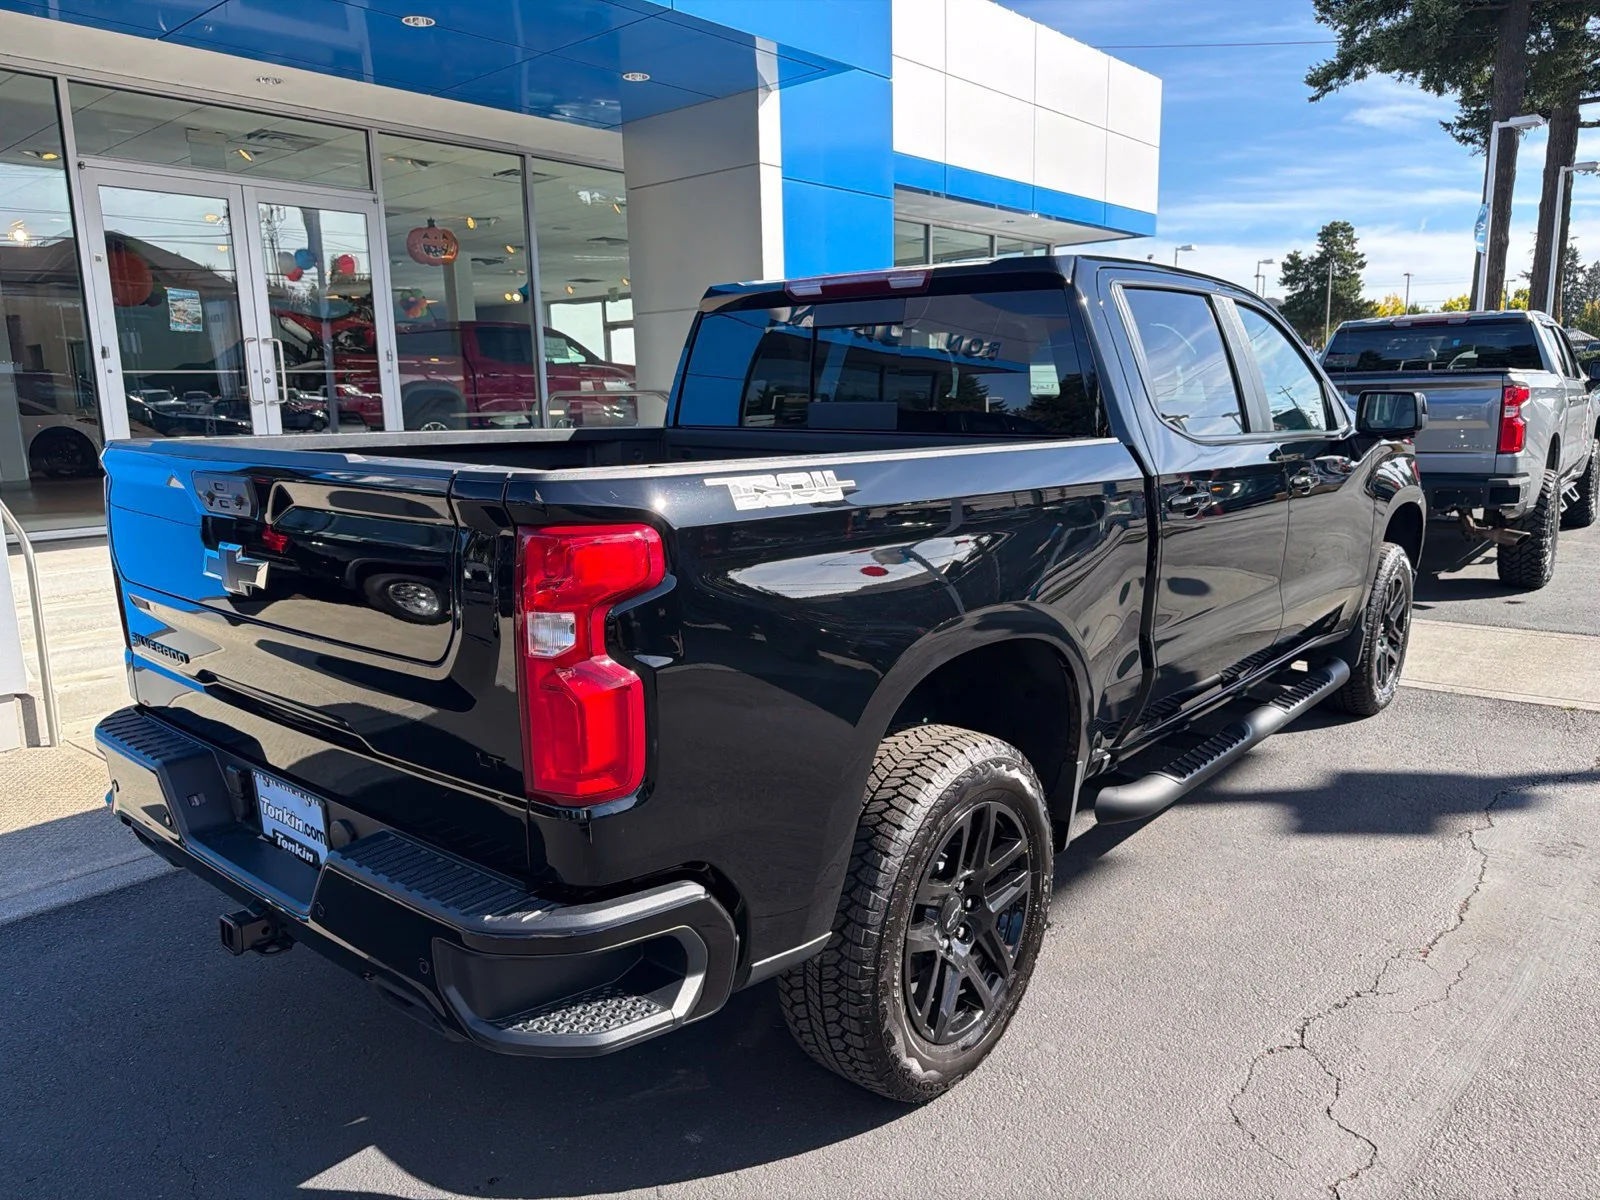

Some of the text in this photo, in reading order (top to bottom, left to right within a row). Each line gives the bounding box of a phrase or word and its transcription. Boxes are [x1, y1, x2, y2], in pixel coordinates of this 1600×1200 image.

[703, 470, 856, 498] TRAIL
[260, 796, 326, 845] Tonkin.com
[275, 832, 314, 863] Tonkin
